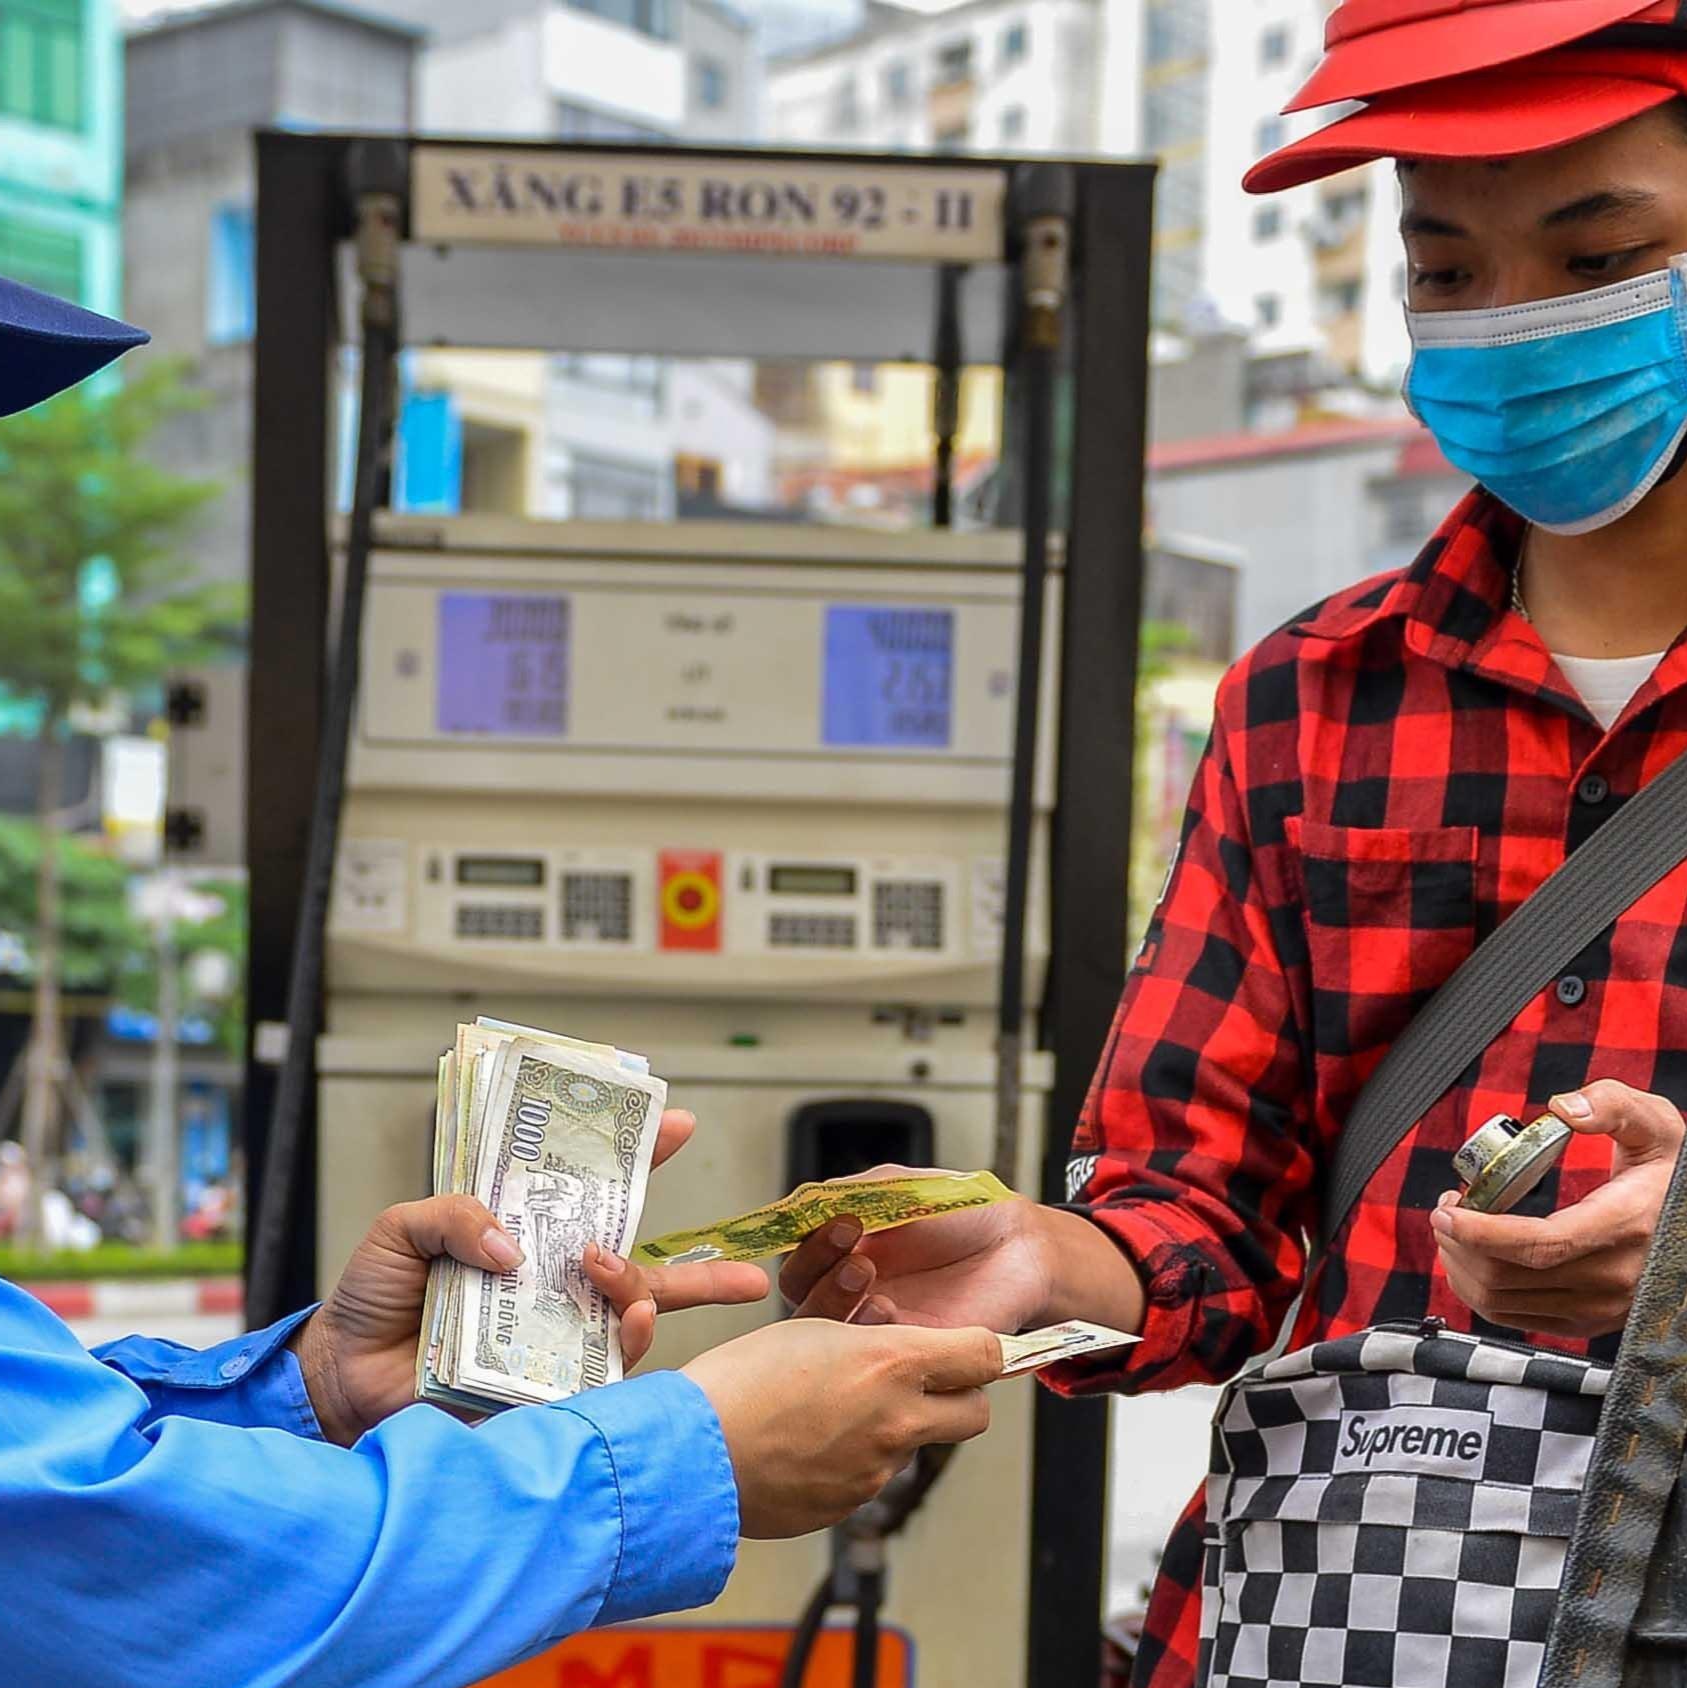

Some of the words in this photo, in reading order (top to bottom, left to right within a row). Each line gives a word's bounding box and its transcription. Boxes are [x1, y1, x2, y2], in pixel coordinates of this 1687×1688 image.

[444, 164, 602, 218] XĂNG
[618, 174, 683, 217] E5
[697, 180, 818, 225] RON
[832, 185, 886, 230] 92
[509, 1096, 552, 1163] 1000
[496, 1298, 520, 1345] ĐỒNG
[1341, 1416, 1483, 1467] Supreme
